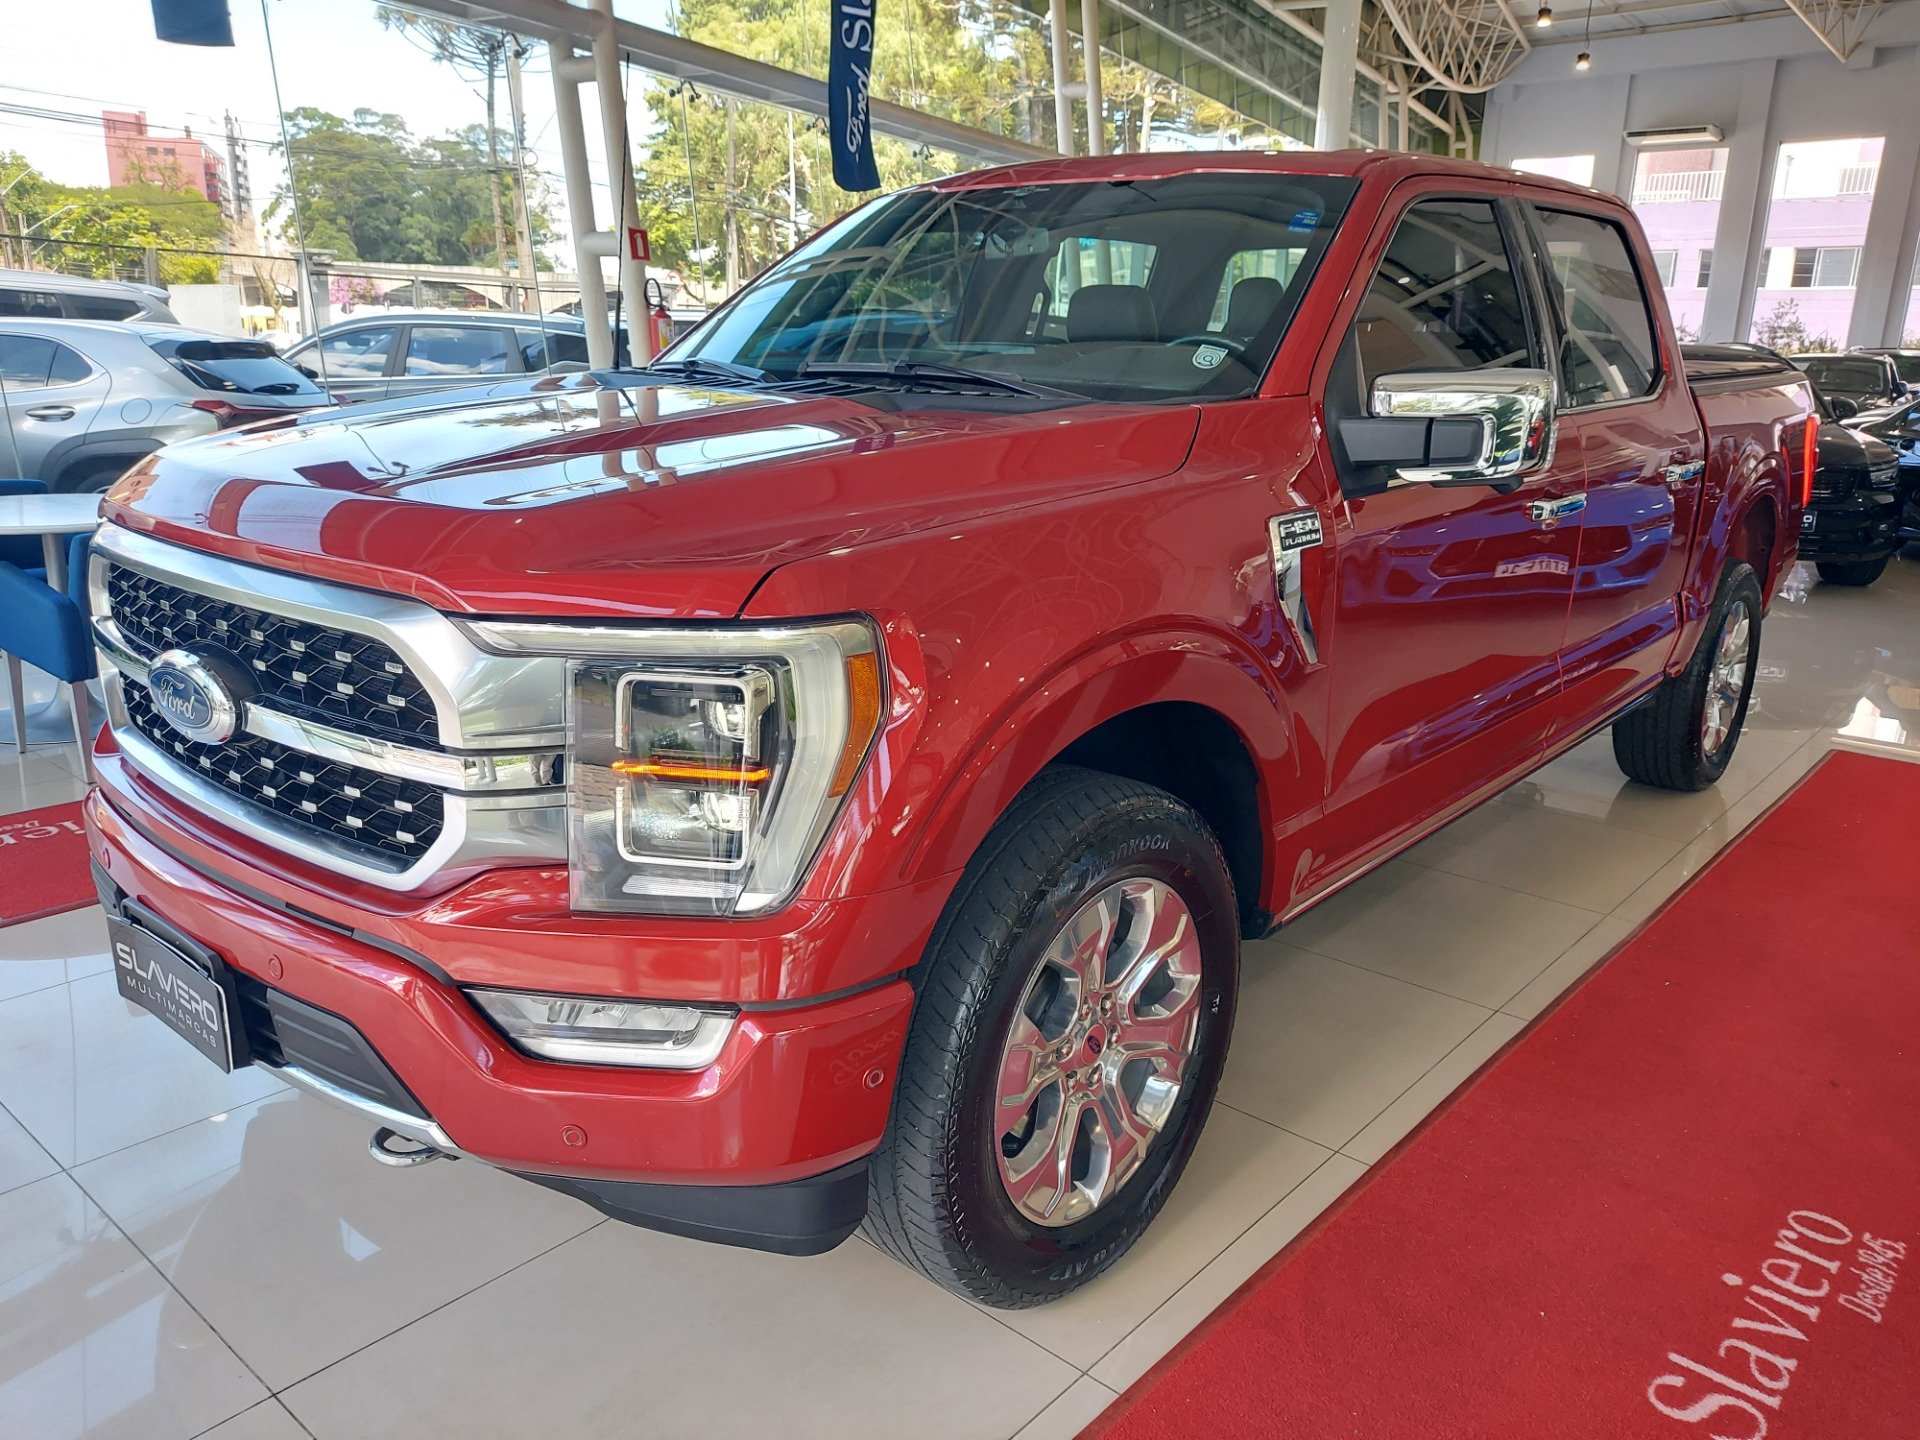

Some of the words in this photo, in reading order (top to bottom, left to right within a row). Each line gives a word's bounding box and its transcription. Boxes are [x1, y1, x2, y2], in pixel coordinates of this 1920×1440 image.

[841, 0, 872, 52] Sl
[1284, 532, 1320, 546] PLATINUM
[160, 674, 196, 720] Ford
[116, 942, 219, 1032] SLAVIERO
[126, 975, 217, 1048] MULTIMARCAS
[1648, 1210, 1853, 1440] Slaviero
